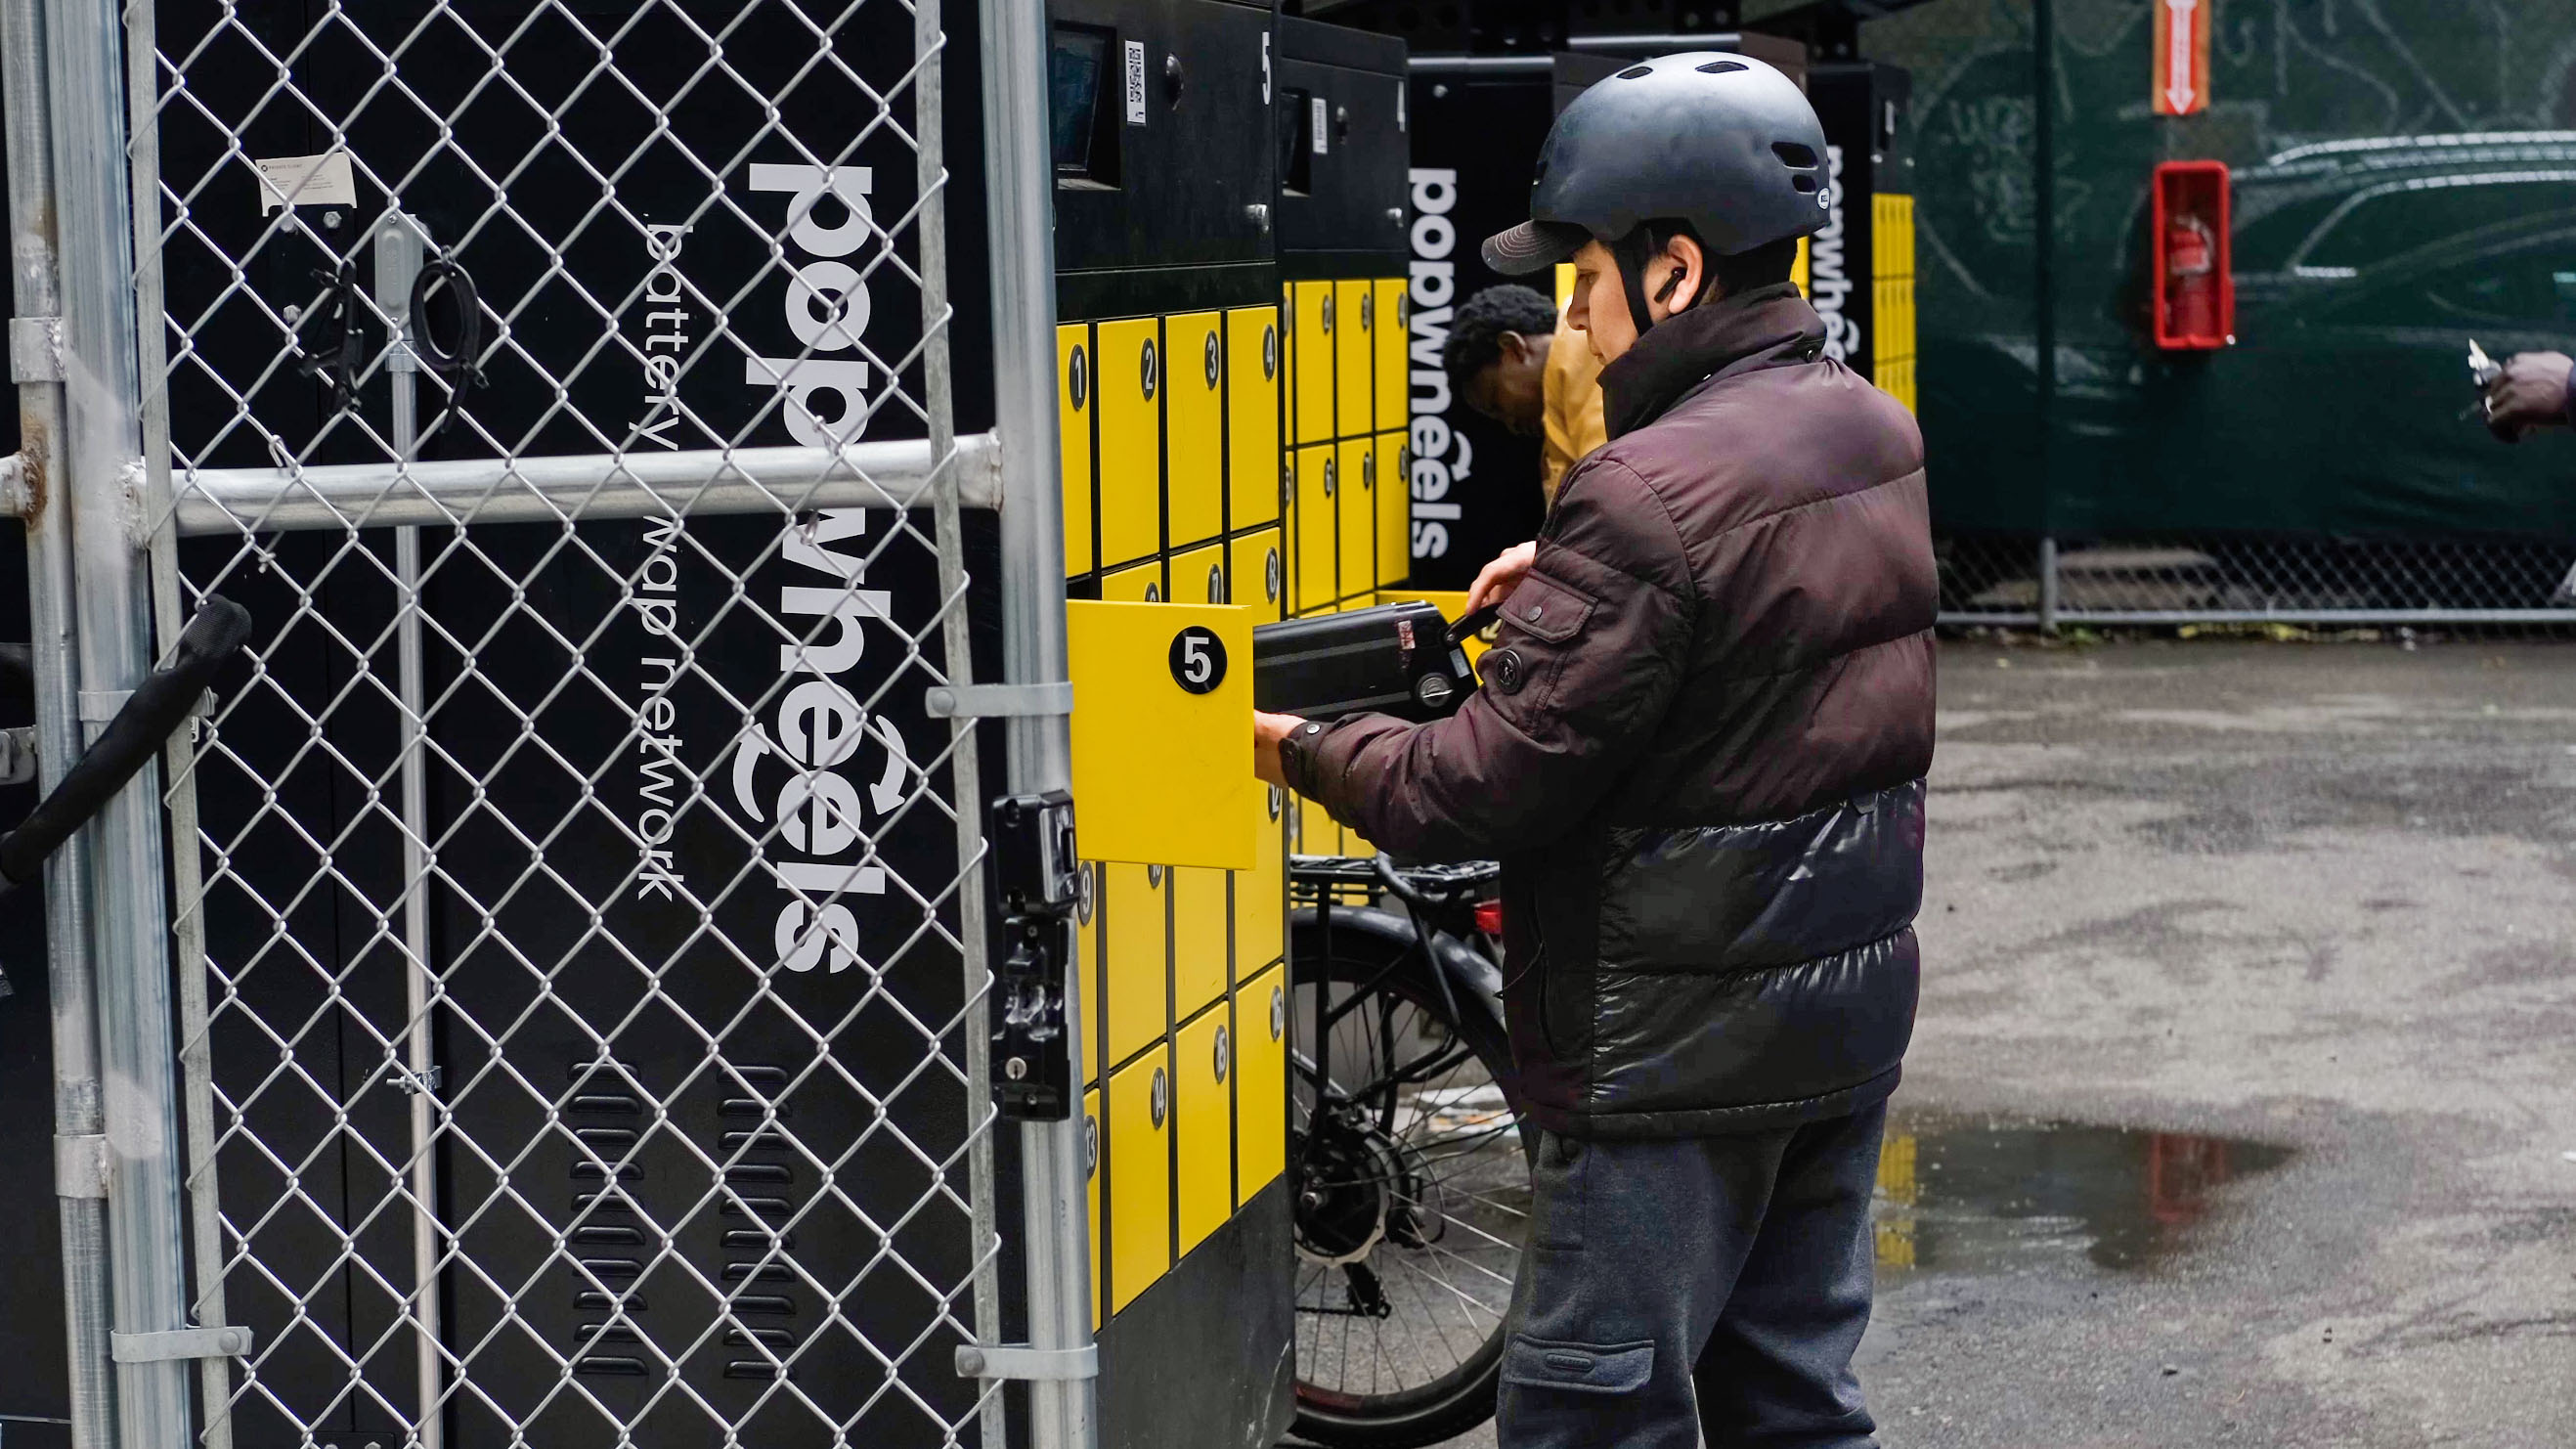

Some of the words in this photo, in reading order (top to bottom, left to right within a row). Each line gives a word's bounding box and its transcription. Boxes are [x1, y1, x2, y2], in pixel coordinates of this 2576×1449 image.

[1262, 31, 1271, 105] 5
[629, 224, 693, 451] battery
[1265, 336, 1274, 372] 4
[1075, 355, 1083, 398] 1
[1144, 351, 1154, 390] 2
[1207, 342, 1217, 379] 3
[1409, 168, 1462, 558] popwheels
[632, 515, 677, 636] wap
[746, 163, 891, 974] popwheels
[1268, 555, 1277, 593] 8
[1184, 636, 1212, 683] 5
[638, 657, 684, 902] network
[1081, 878, 1092, 913] 9
[1154, 1077, 1165, 1117] 14
[1085, 1125, 1096, 1168] 13
